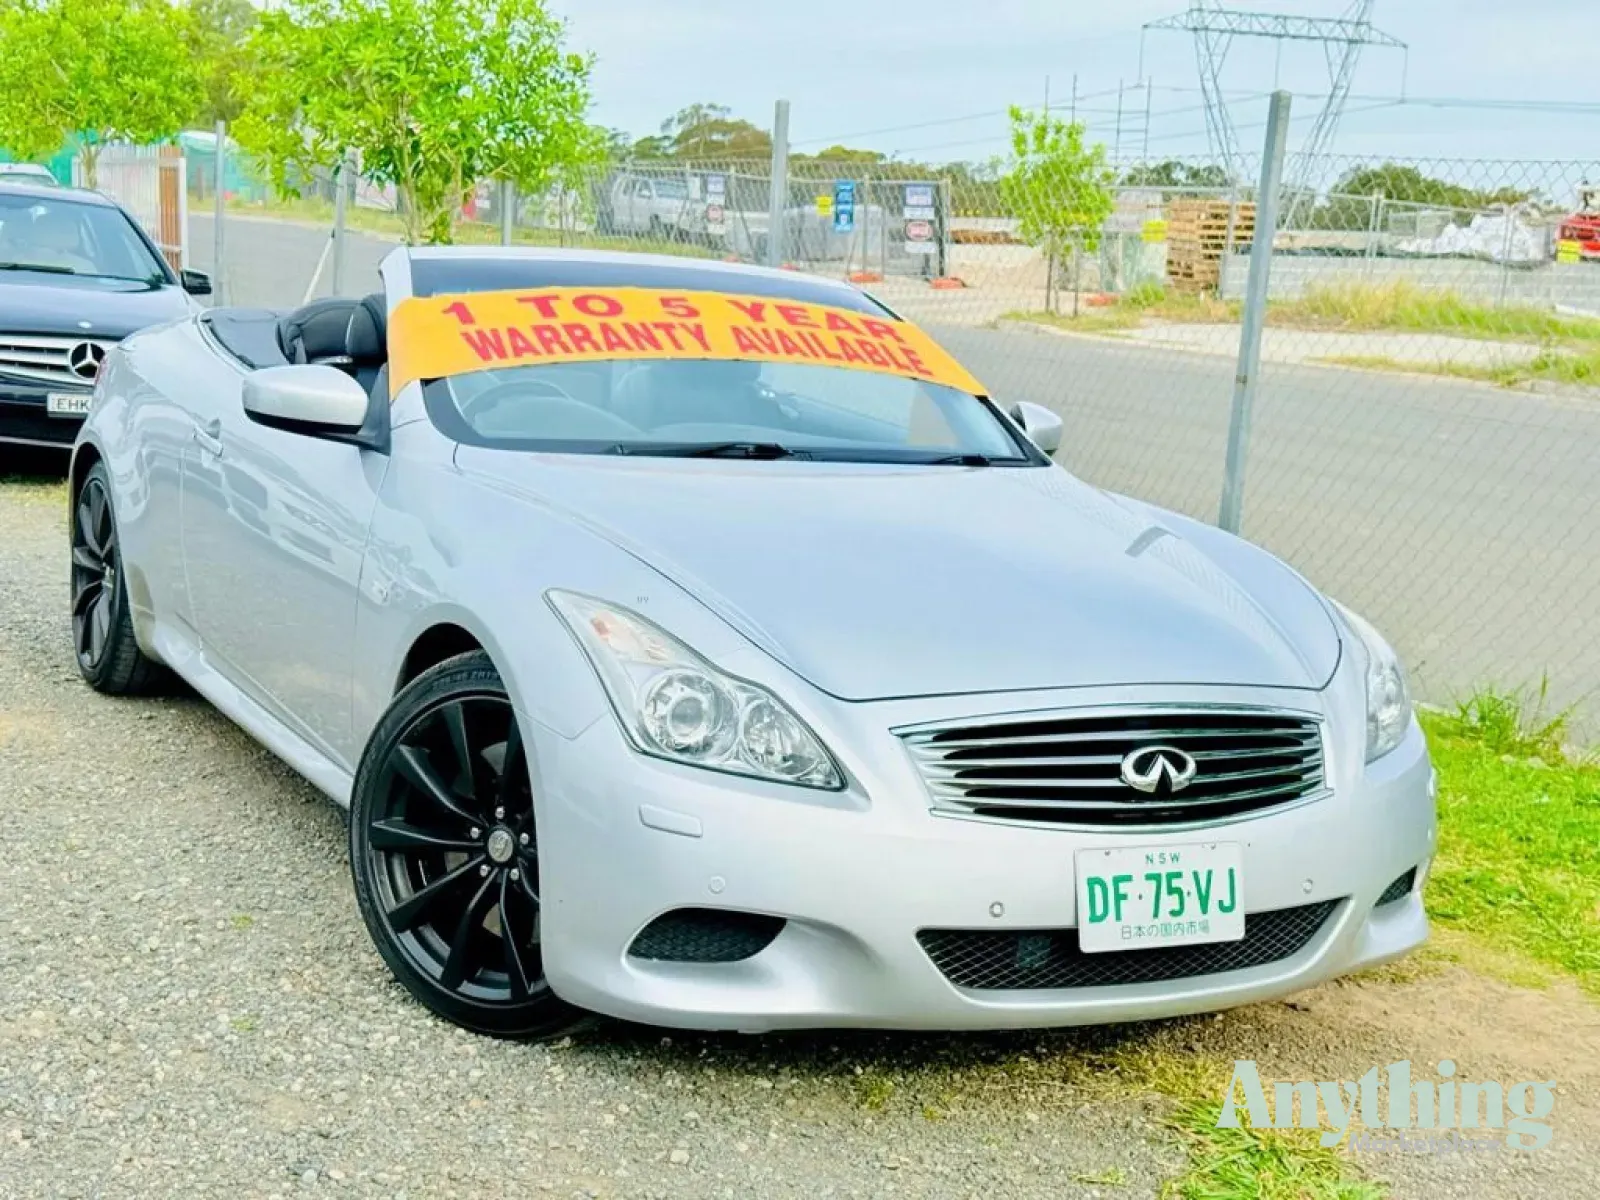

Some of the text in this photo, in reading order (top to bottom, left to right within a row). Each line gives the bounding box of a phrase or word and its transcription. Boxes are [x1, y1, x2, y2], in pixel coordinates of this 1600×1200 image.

[442, 294, 907, 343] 1 TO 5 YEAR
[460, 321, 934, 377] WARRANTY AVAILABLE
